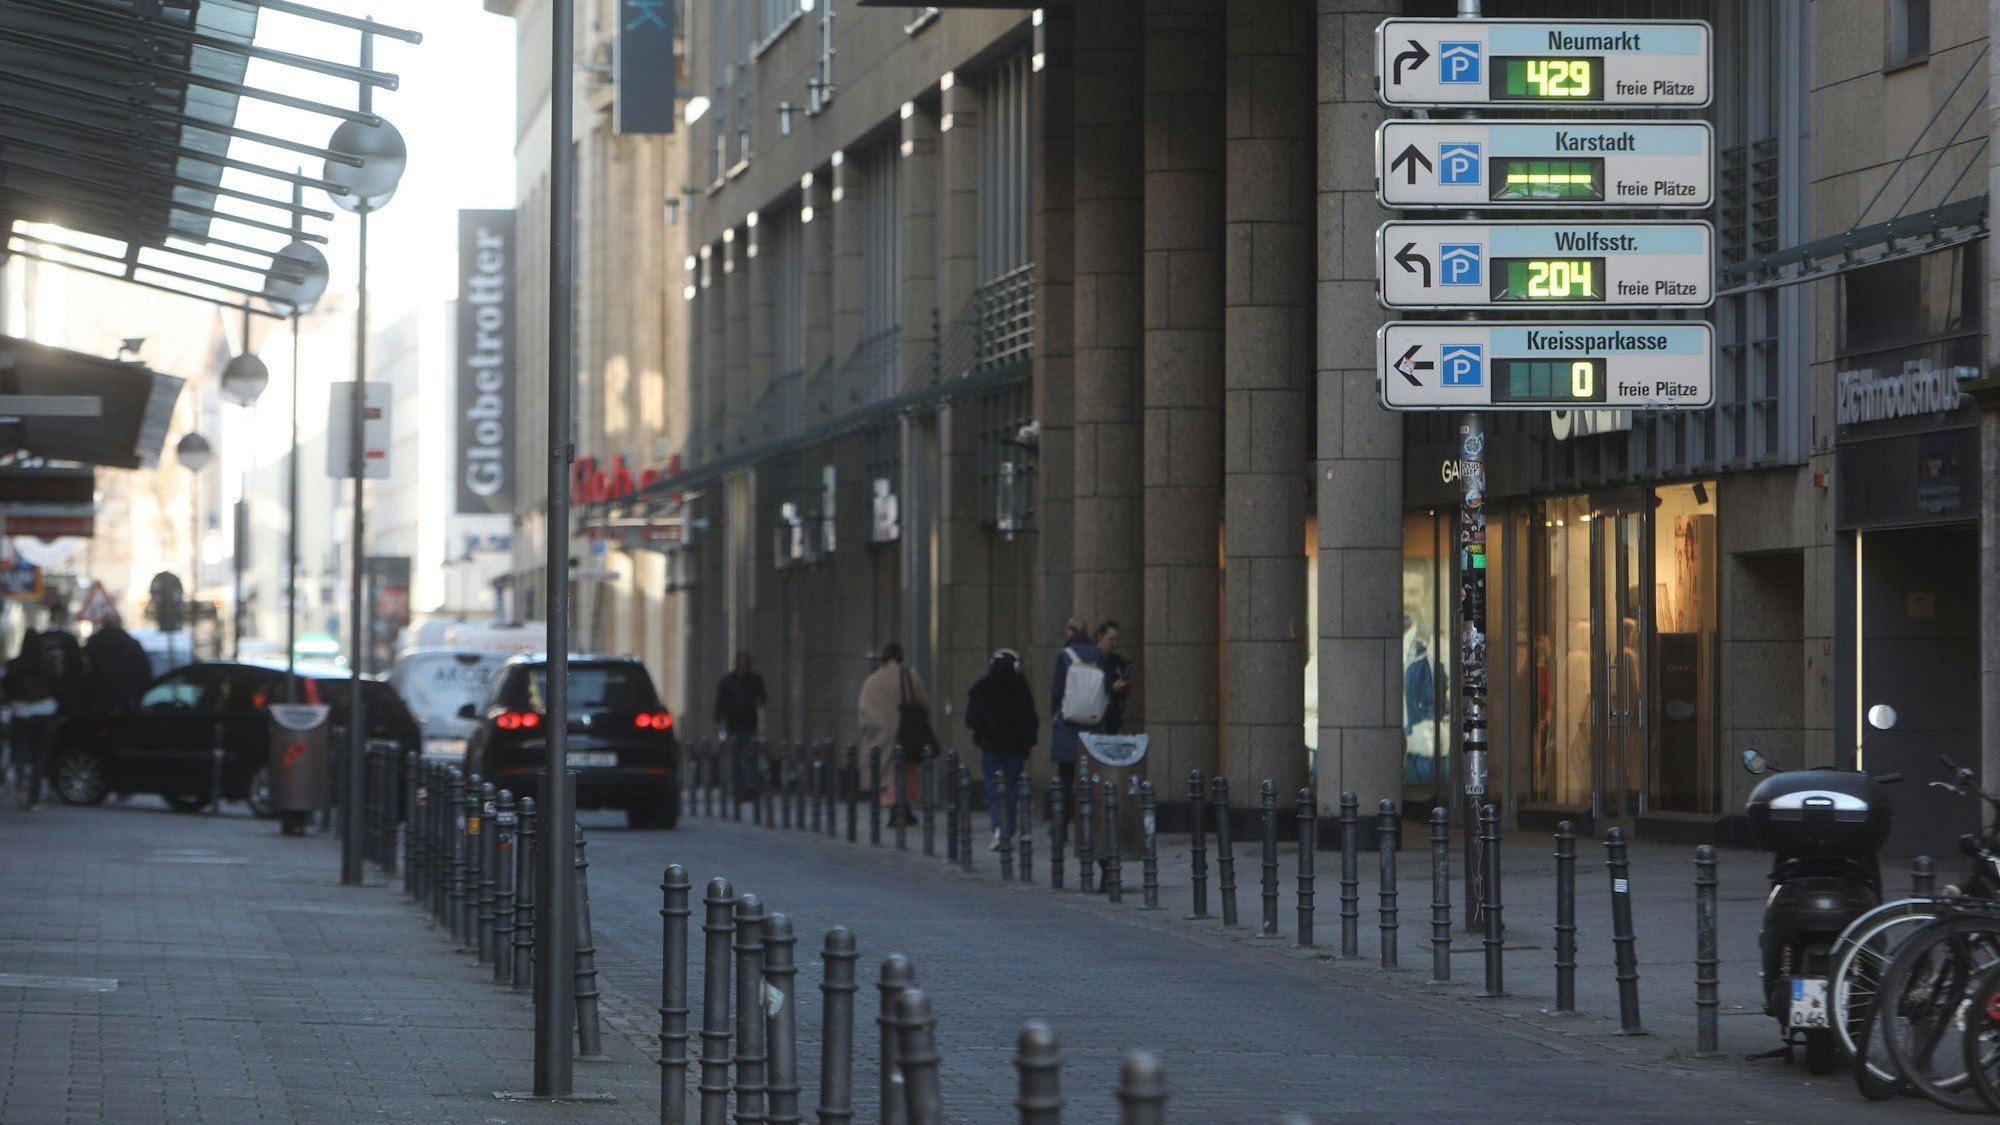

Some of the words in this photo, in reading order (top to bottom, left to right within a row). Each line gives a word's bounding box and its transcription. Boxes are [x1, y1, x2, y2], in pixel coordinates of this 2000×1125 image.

[1549, 31, 1641, 50] Neumarkt
[1527, 60, 1591, 96] 429
[1616, 81, 1648, 96] freie
[1653, 81, 1695, 96] Plätze
[1556, 132, 1636, 151] Karstadt
[1617, 181, 1648, 196] freie
[1654, 181, 1696, 196] Plätze
[1555, 231, 1638, 251] Wolfsstr.
[1528, 261, 1592, 297] 204
[1617, 281, 1649, 296] freie
[1655, 281, 1697, 296] Plätze
[1527, 331, 1668, 354] Kreissparkasse
[466, 227, 505, 497] Globetrotter
[1571, 361, 1594, 398] 0
[1618, 382, 1650, 396] freie
[1656, 381, 1698, 396] Plätze
